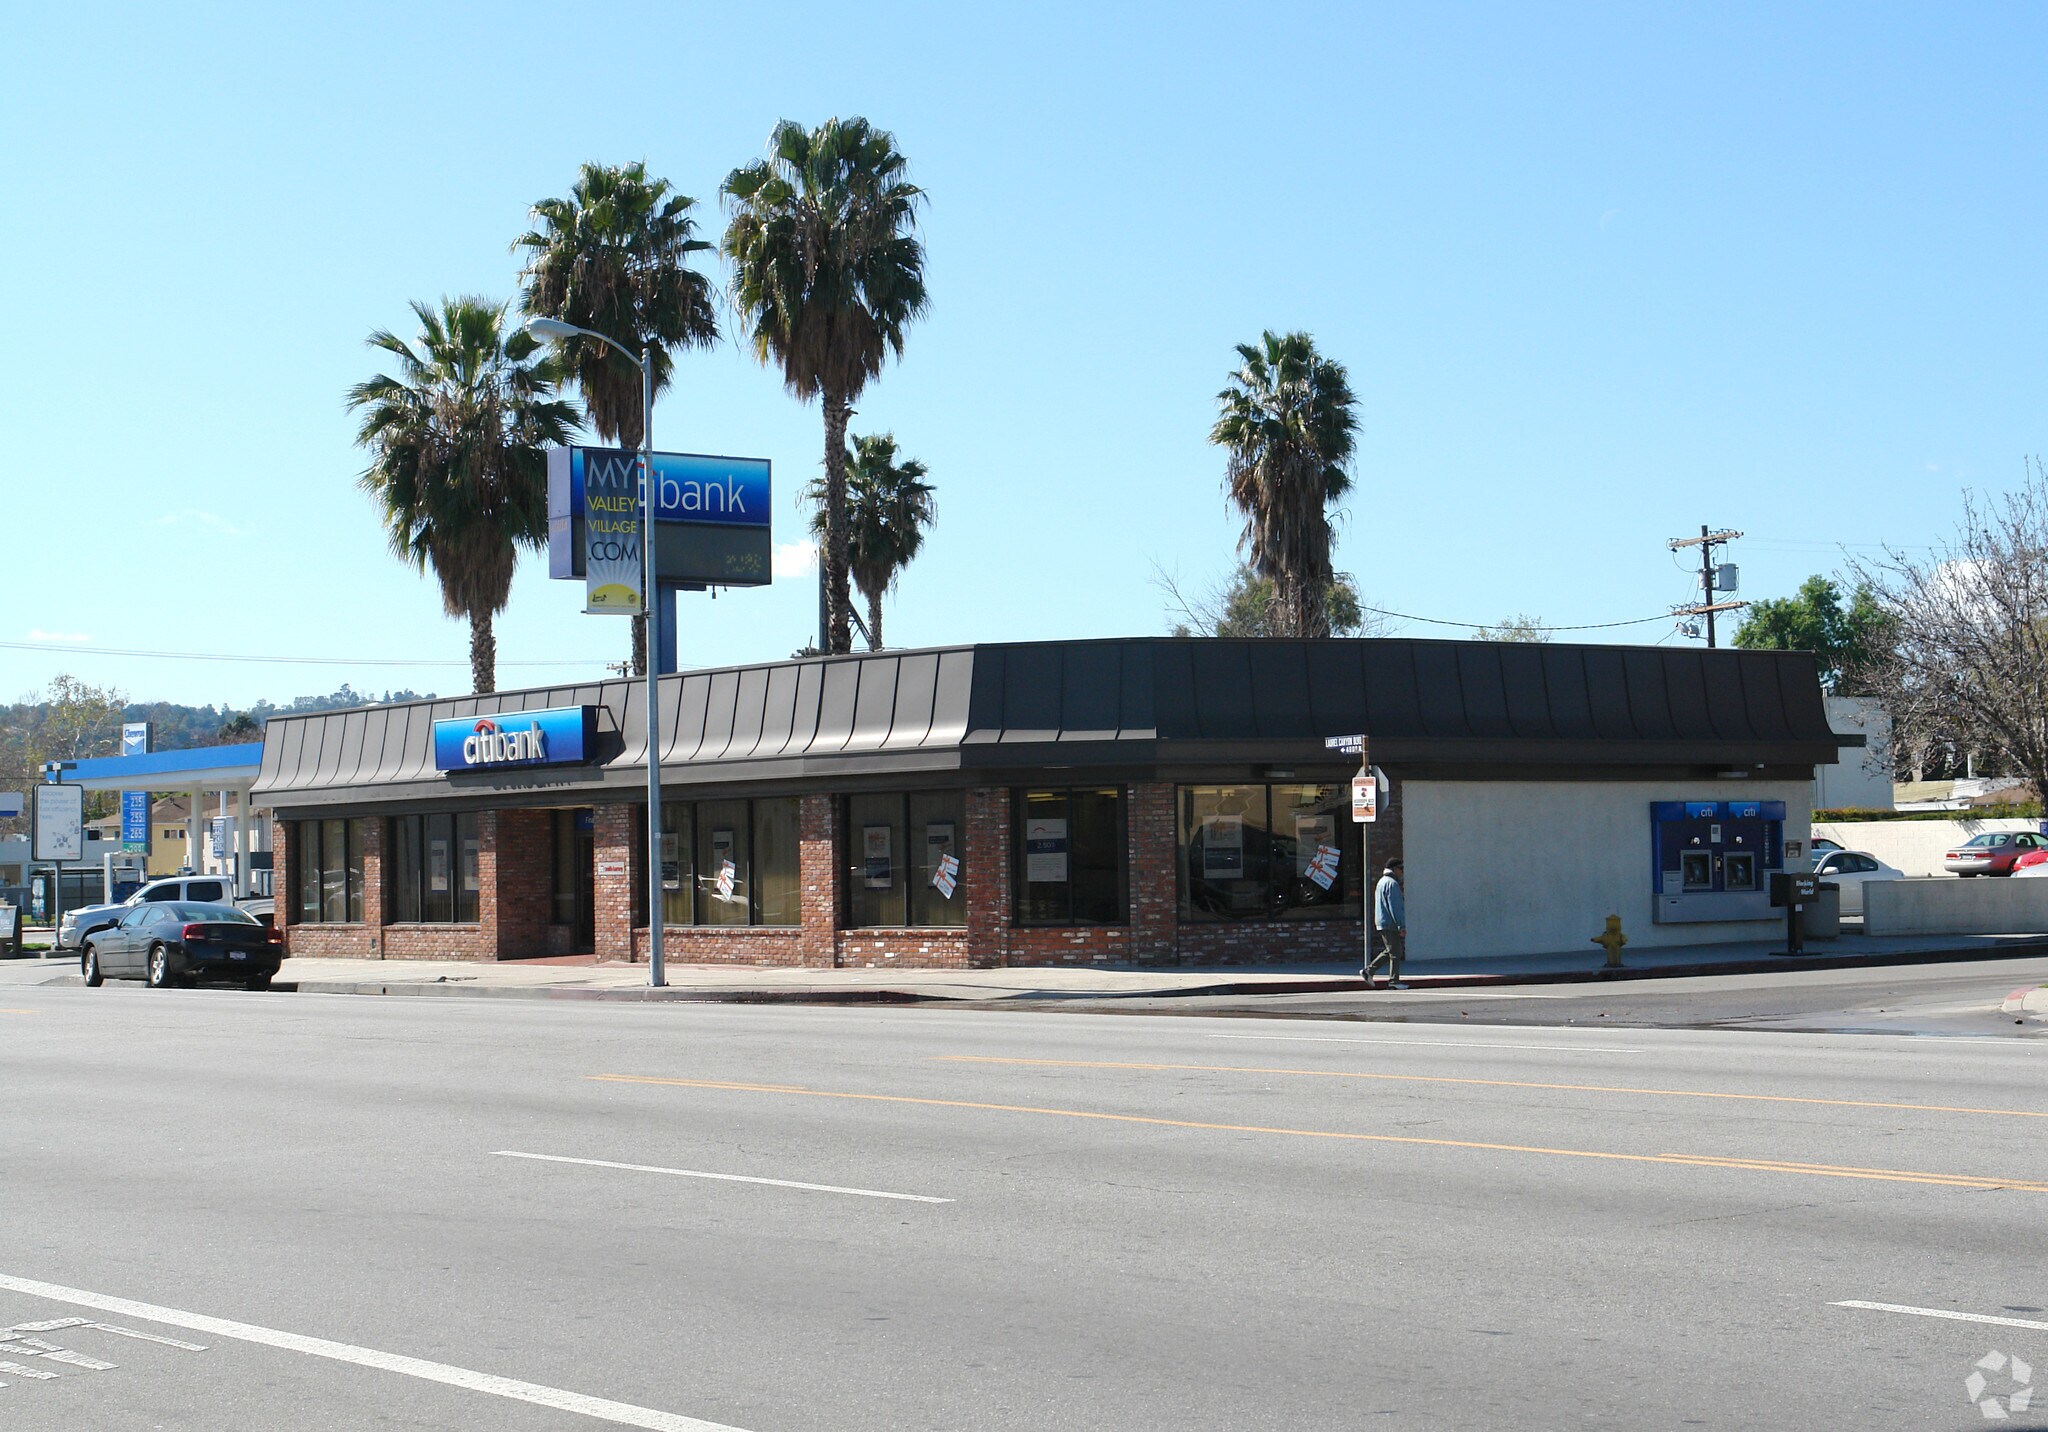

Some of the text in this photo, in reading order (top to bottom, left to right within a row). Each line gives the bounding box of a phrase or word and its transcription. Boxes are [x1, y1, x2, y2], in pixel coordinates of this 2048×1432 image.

[587, 457, 635, 489] MY
[587, 495, 636, 513] VALLEY
[588, 519, 637, 534] VILLAGE
[588, 541, 638, 562] .COM
[463, 720, 545, 764] citibank
